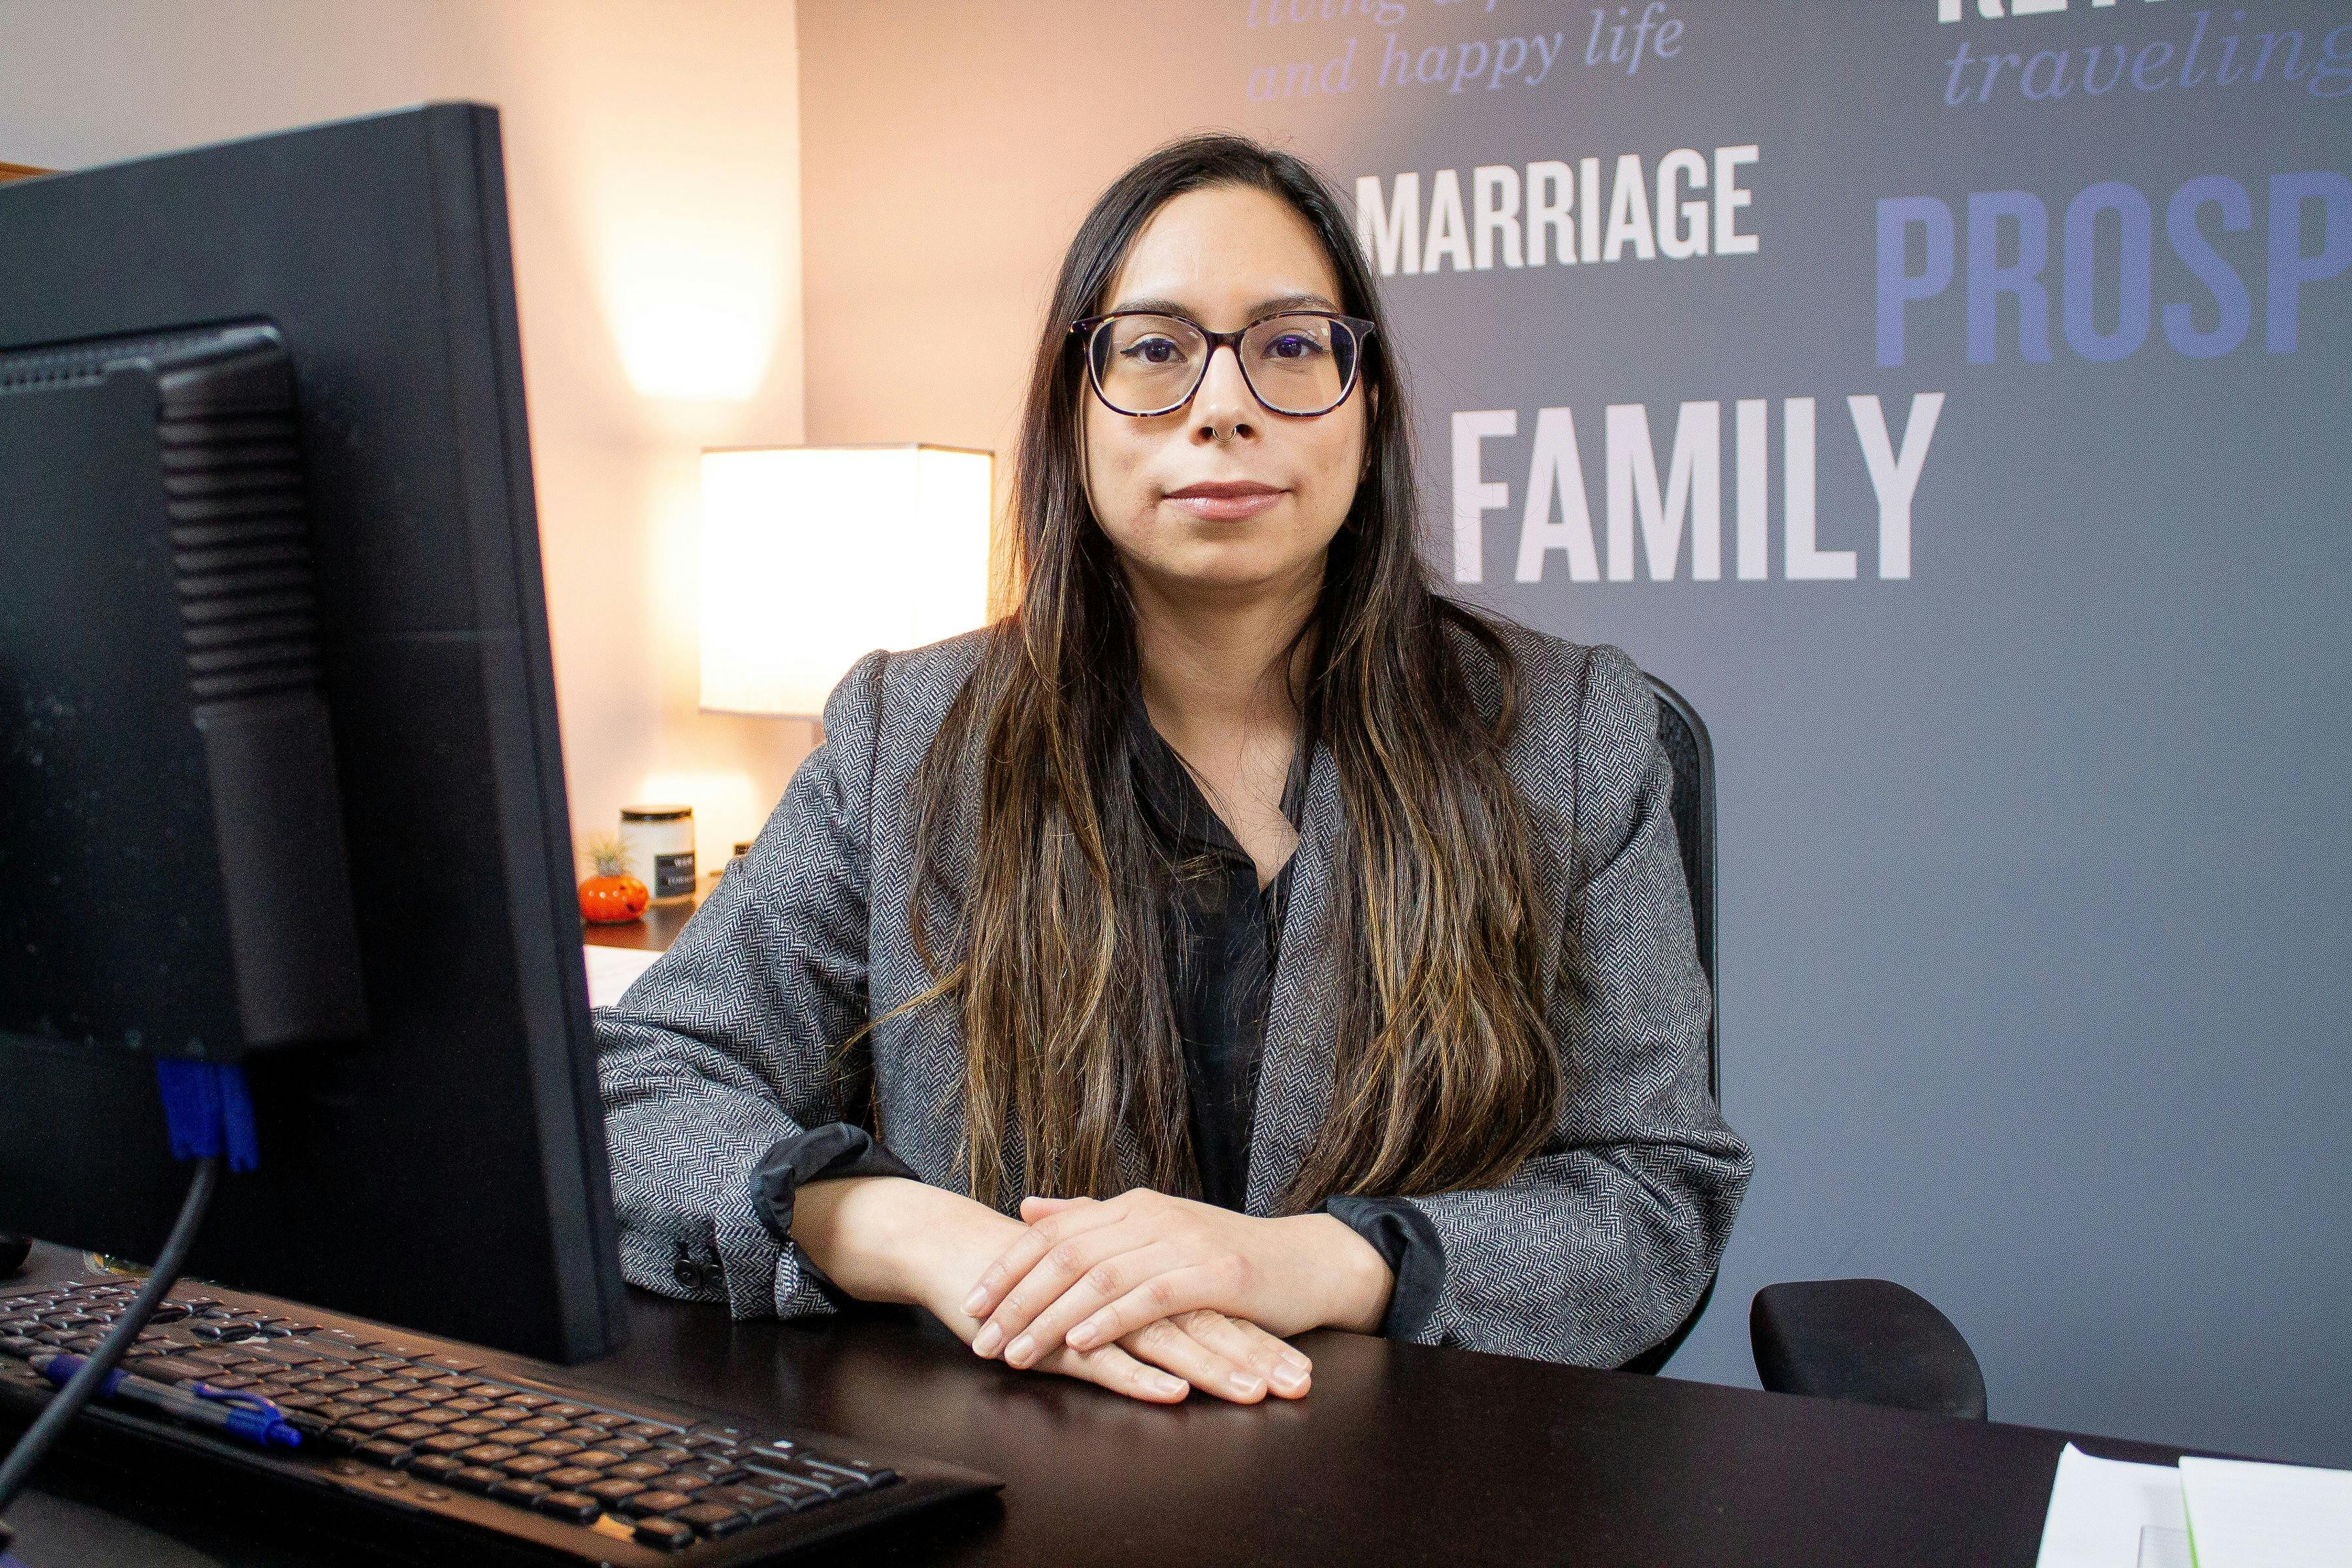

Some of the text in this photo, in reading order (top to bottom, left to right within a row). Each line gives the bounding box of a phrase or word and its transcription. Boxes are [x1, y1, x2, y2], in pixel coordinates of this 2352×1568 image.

[1247, 1, 1684, 103] and happy life
[1944, 10, 2352, 106] traveling
[1356, 144, 1760, 276] MARRIAGE
[1874, 170, 2352, 368] PROSP
[1451, 392, 1946, 583] FAMILY
